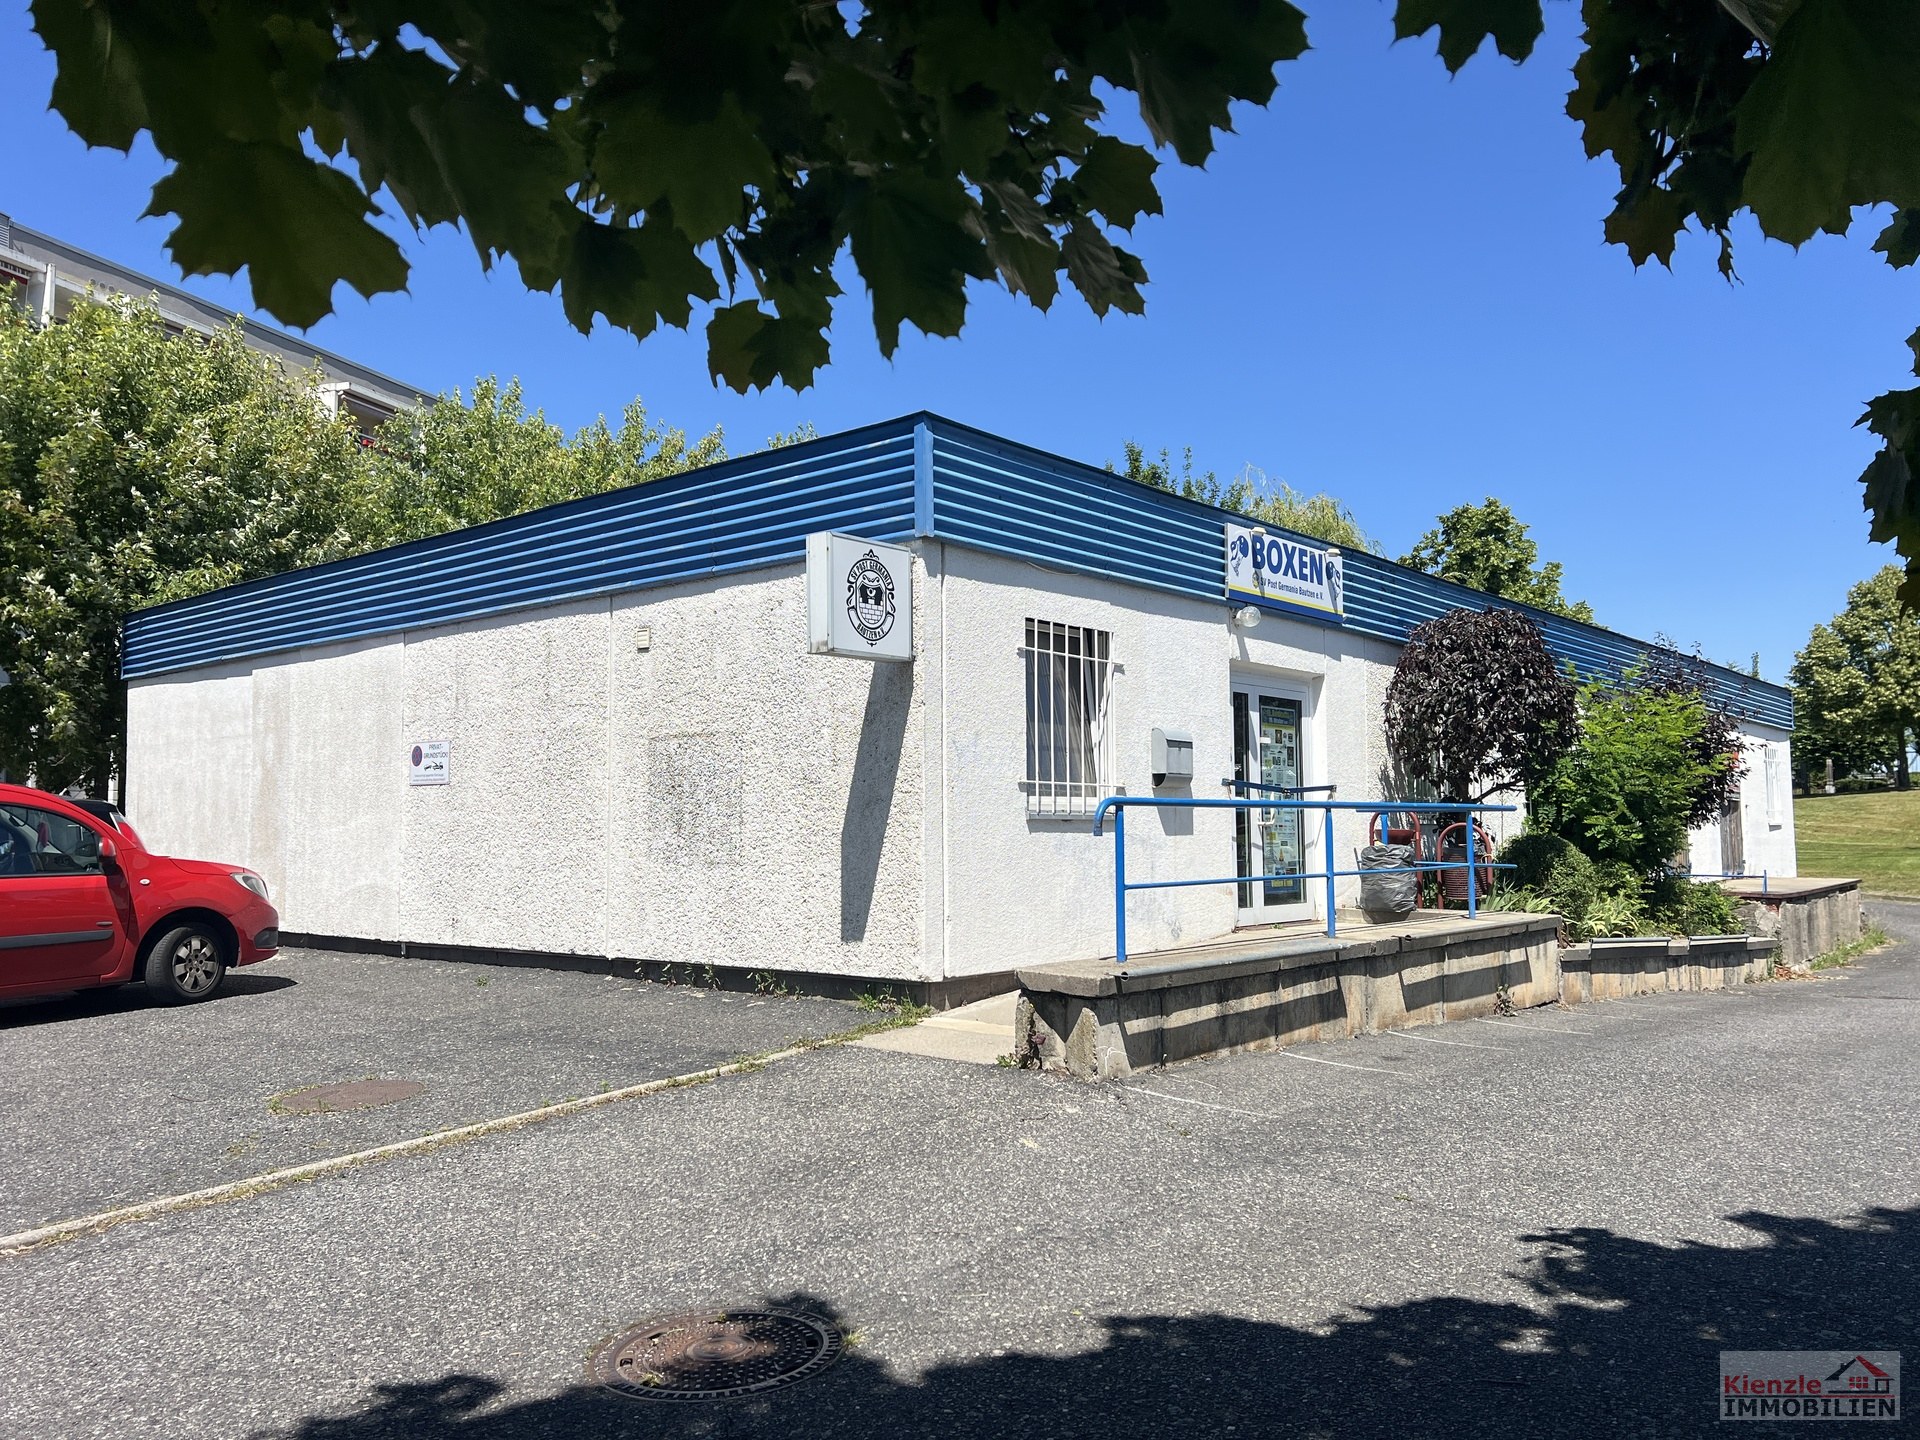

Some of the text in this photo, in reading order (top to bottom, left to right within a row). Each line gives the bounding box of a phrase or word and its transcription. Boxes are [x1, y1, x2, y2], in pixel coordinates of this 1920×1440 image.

[1252, 535, 1323, 586] BOXEN
[851, 561, 892, 587] SV POST GERMANIA
[1267, 578, 1278, 589] Post
[1278, 581, 1298, 594] Germania
[1299, 586, 1315, 598] Bautzen
[857, 622, 877, 639] BAUTZEN
